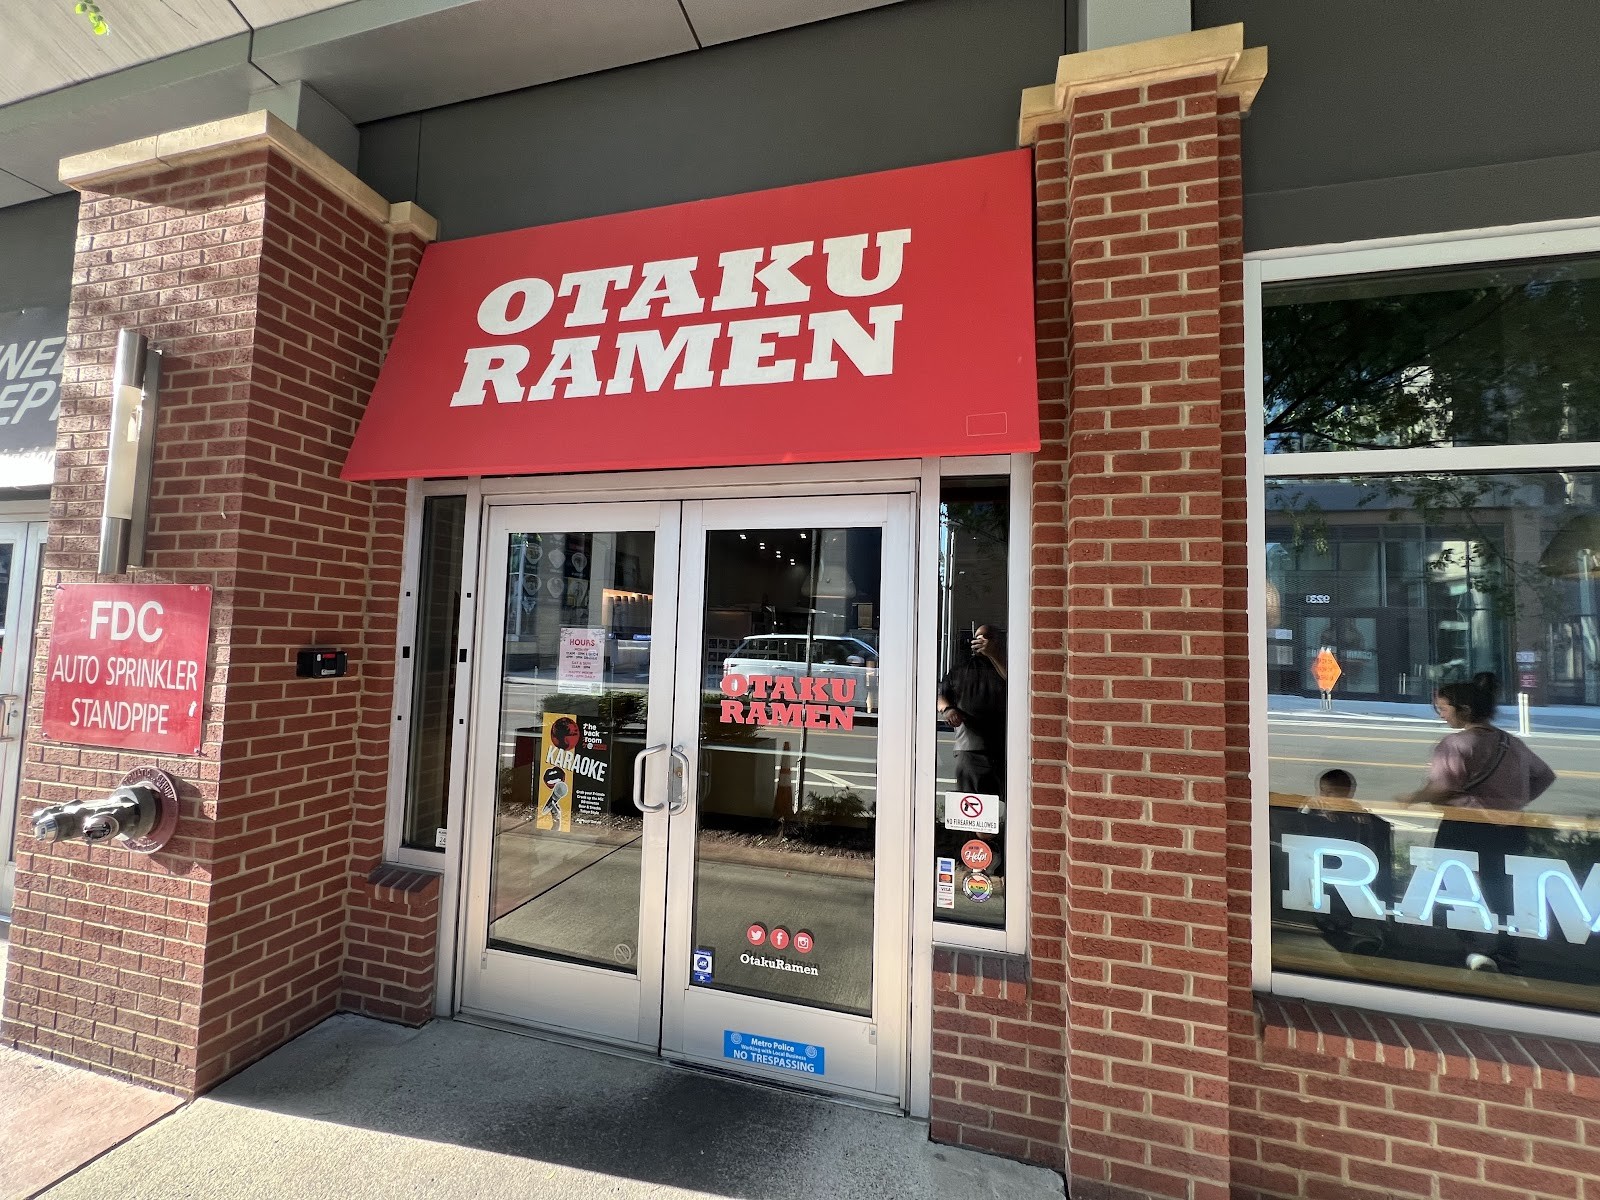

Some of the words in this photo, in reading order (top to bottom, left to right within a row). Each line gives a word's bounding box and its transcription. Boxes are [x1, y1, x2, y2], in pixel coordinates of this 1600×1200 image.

[477, 228, 911, 336] OTAKU
[449, 304, 903, 407] RAMEN
[0, 381, 62, 426] EP
[90, 600, 164, 643] FDC
[52, 655, 99, 684] AUTO
[106, 656, 198, 692] SPRINKLER
[721, 673, 857, 702] OTAKU
[70, 698, 169, 735] STANDPIPE
[719, 700, 855, 731] RAMEN
[583, 729, 600, 738] back
[583, 736, 602, 744] room
[546, 745, 607, 782] KARAOKE
[953, 818, 975, 827] FIREARMS
[976, 821, 997, 829] ALLOWED
[740, 953, 819, 976] OtakuRamen
[740, 1044, 760, 1053] Working
[751, 1037, 772, 1048] Metro
[773, 1042, 795, 1053] Police
[733, 1049, 748, 1060] NO
[751, 1052, 815, 1073] TRESPASSING
